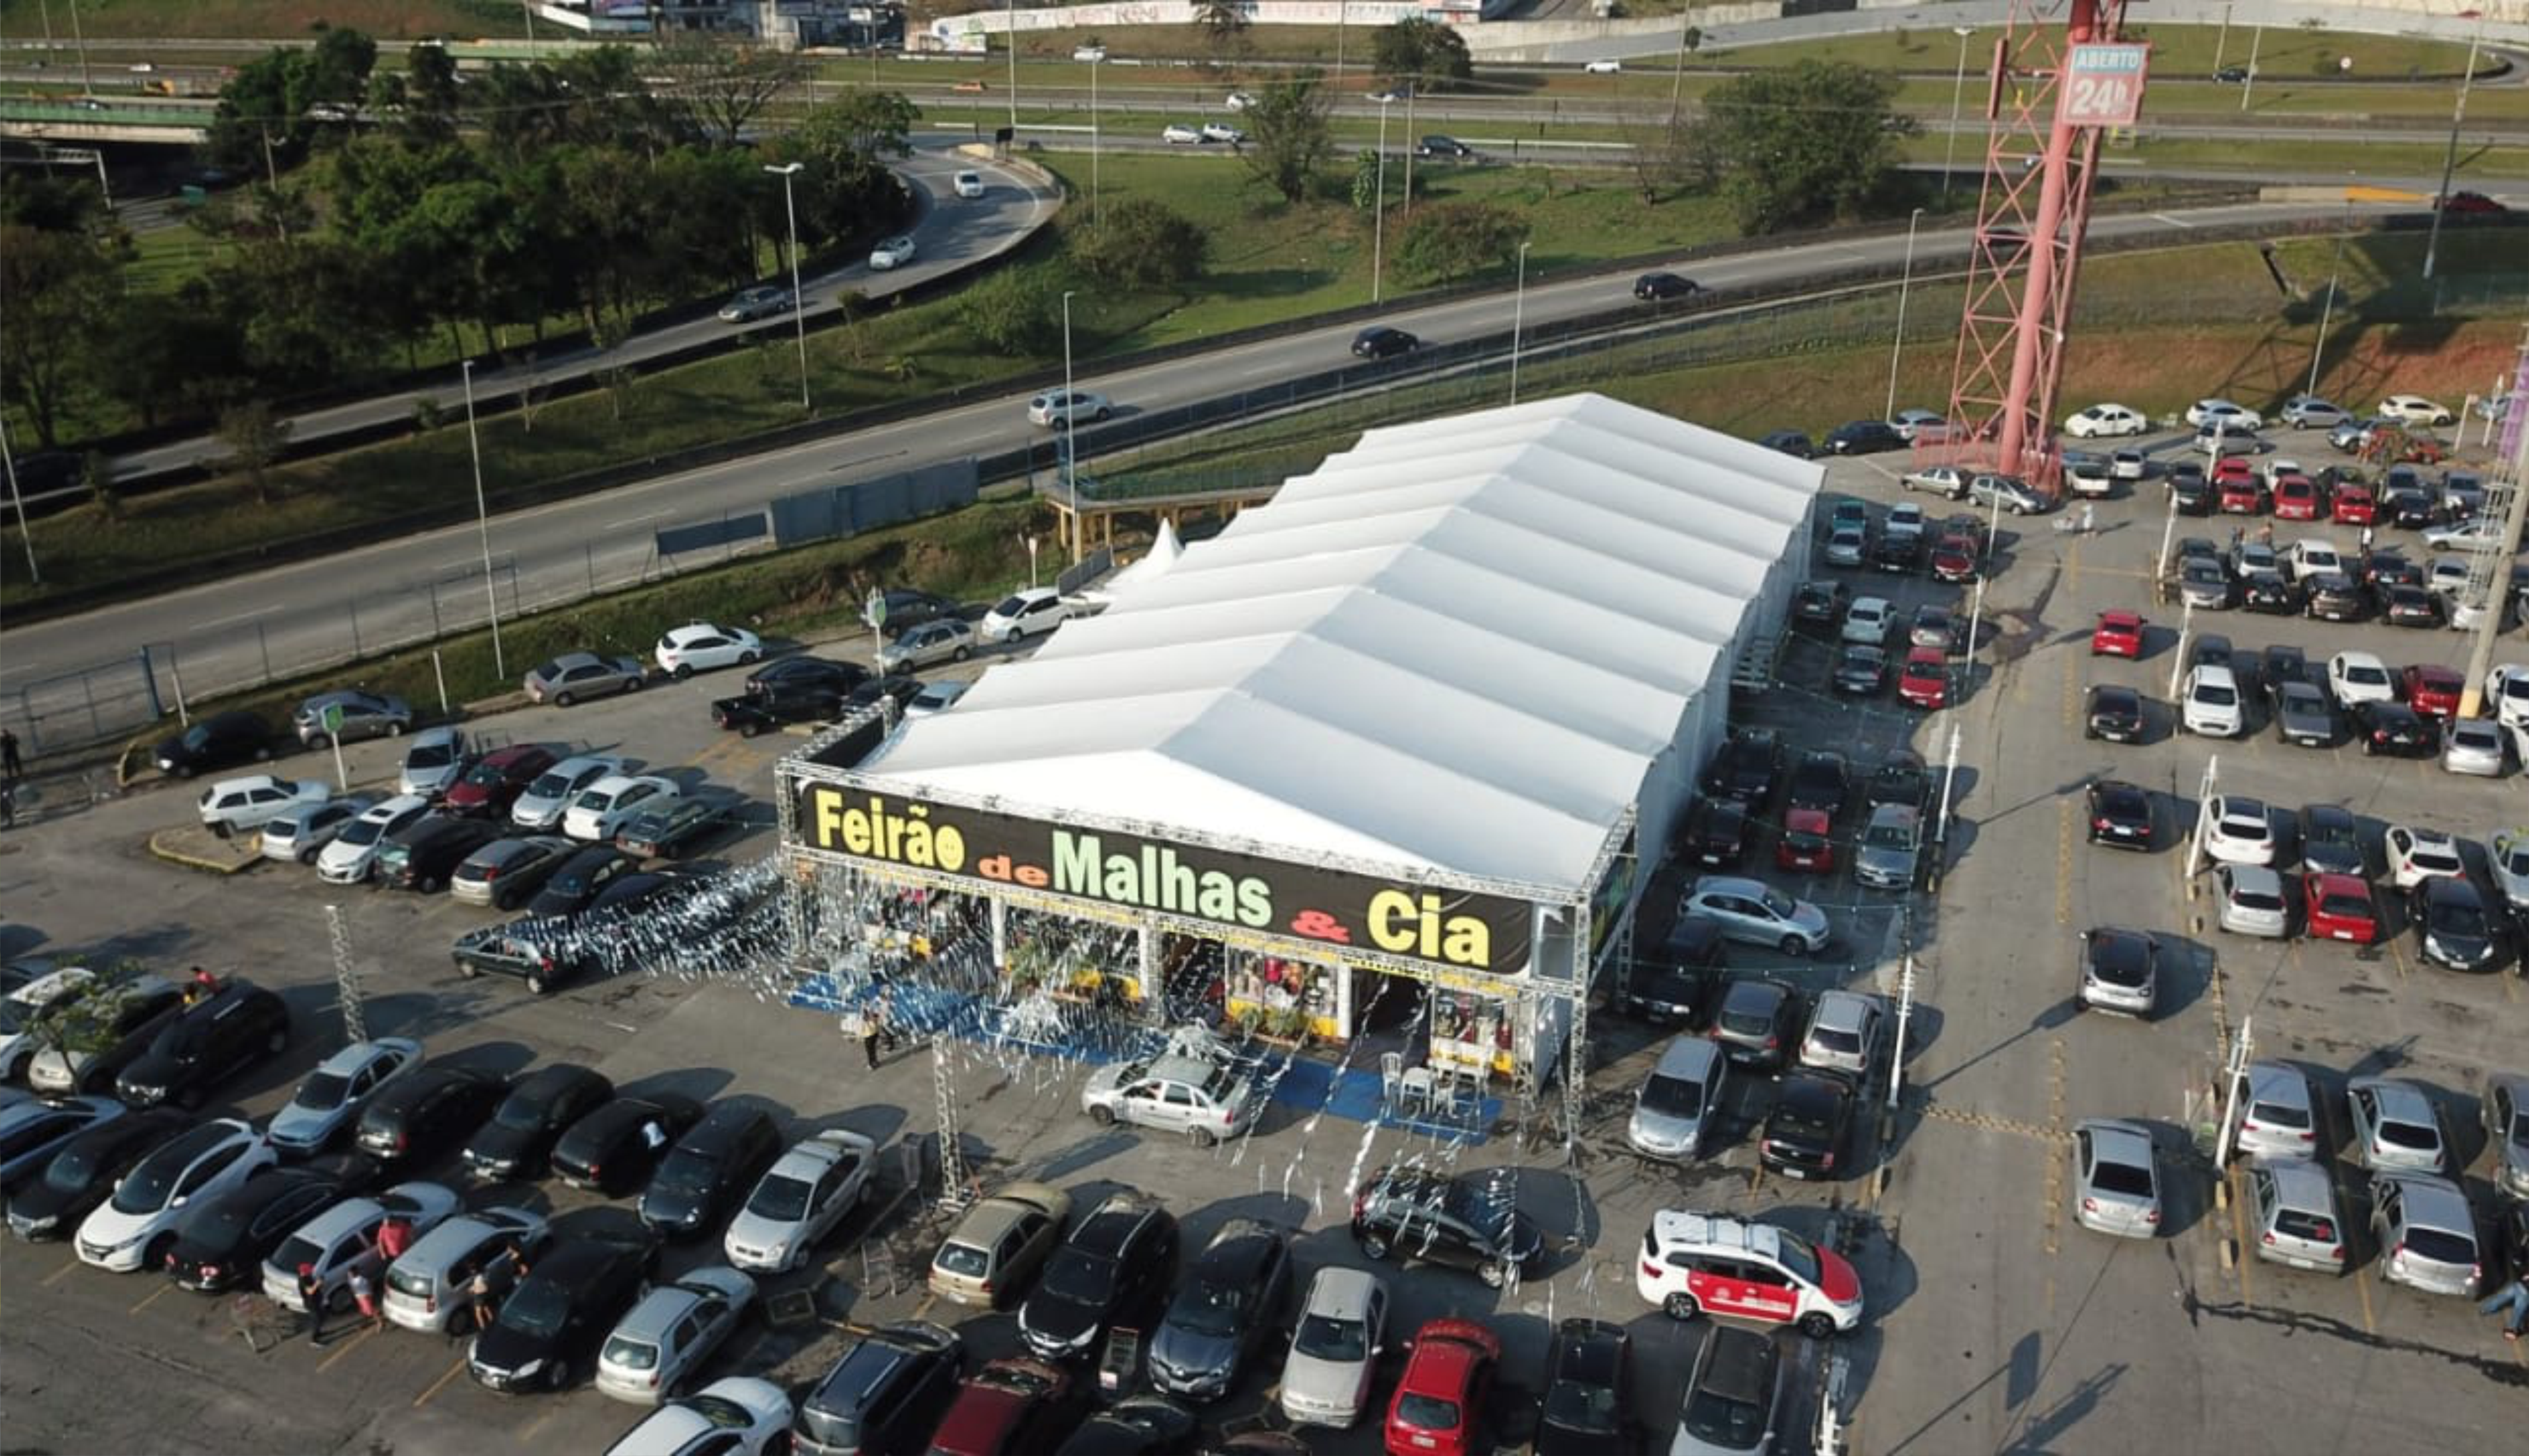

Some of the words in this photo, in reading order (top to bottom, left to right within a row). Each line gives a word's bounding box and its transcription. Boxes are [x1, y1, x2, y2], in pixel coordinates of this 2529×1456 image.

[2075, 49, 2139, 68] ABERTO
[816, 789, 964, 871] Feirão
[977, 854, 1049, 886] de
[1052, 830, 1272, 927] Malhas
[1290, 909, 1350, 943] &
[1368, 889, 1489, 967] Cia
